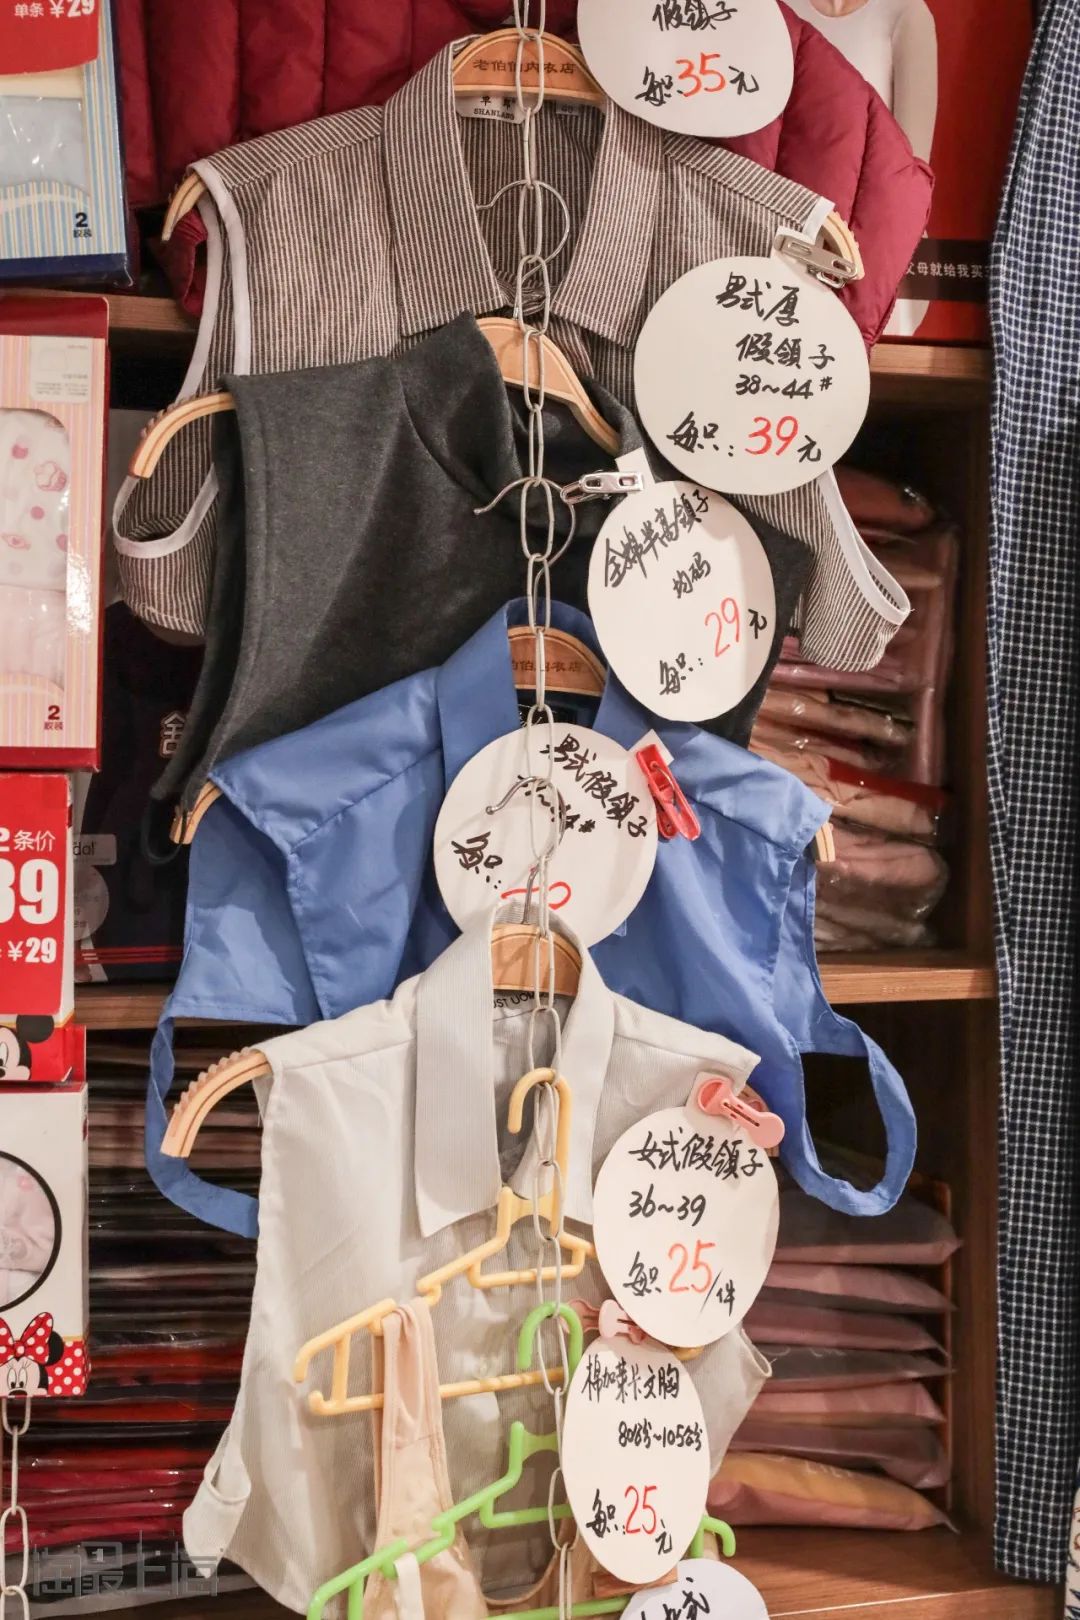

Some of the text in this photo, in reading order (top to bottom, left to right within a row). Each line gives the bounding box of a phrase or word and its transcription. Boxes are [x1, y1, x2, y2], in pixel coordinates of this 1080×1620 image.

[75, 212, 88, 227] 2
[47, 705, 60, 720] 2
[8, 937, 57, 963] ¥29
[628, 1183, 706, 1227] 36~39
